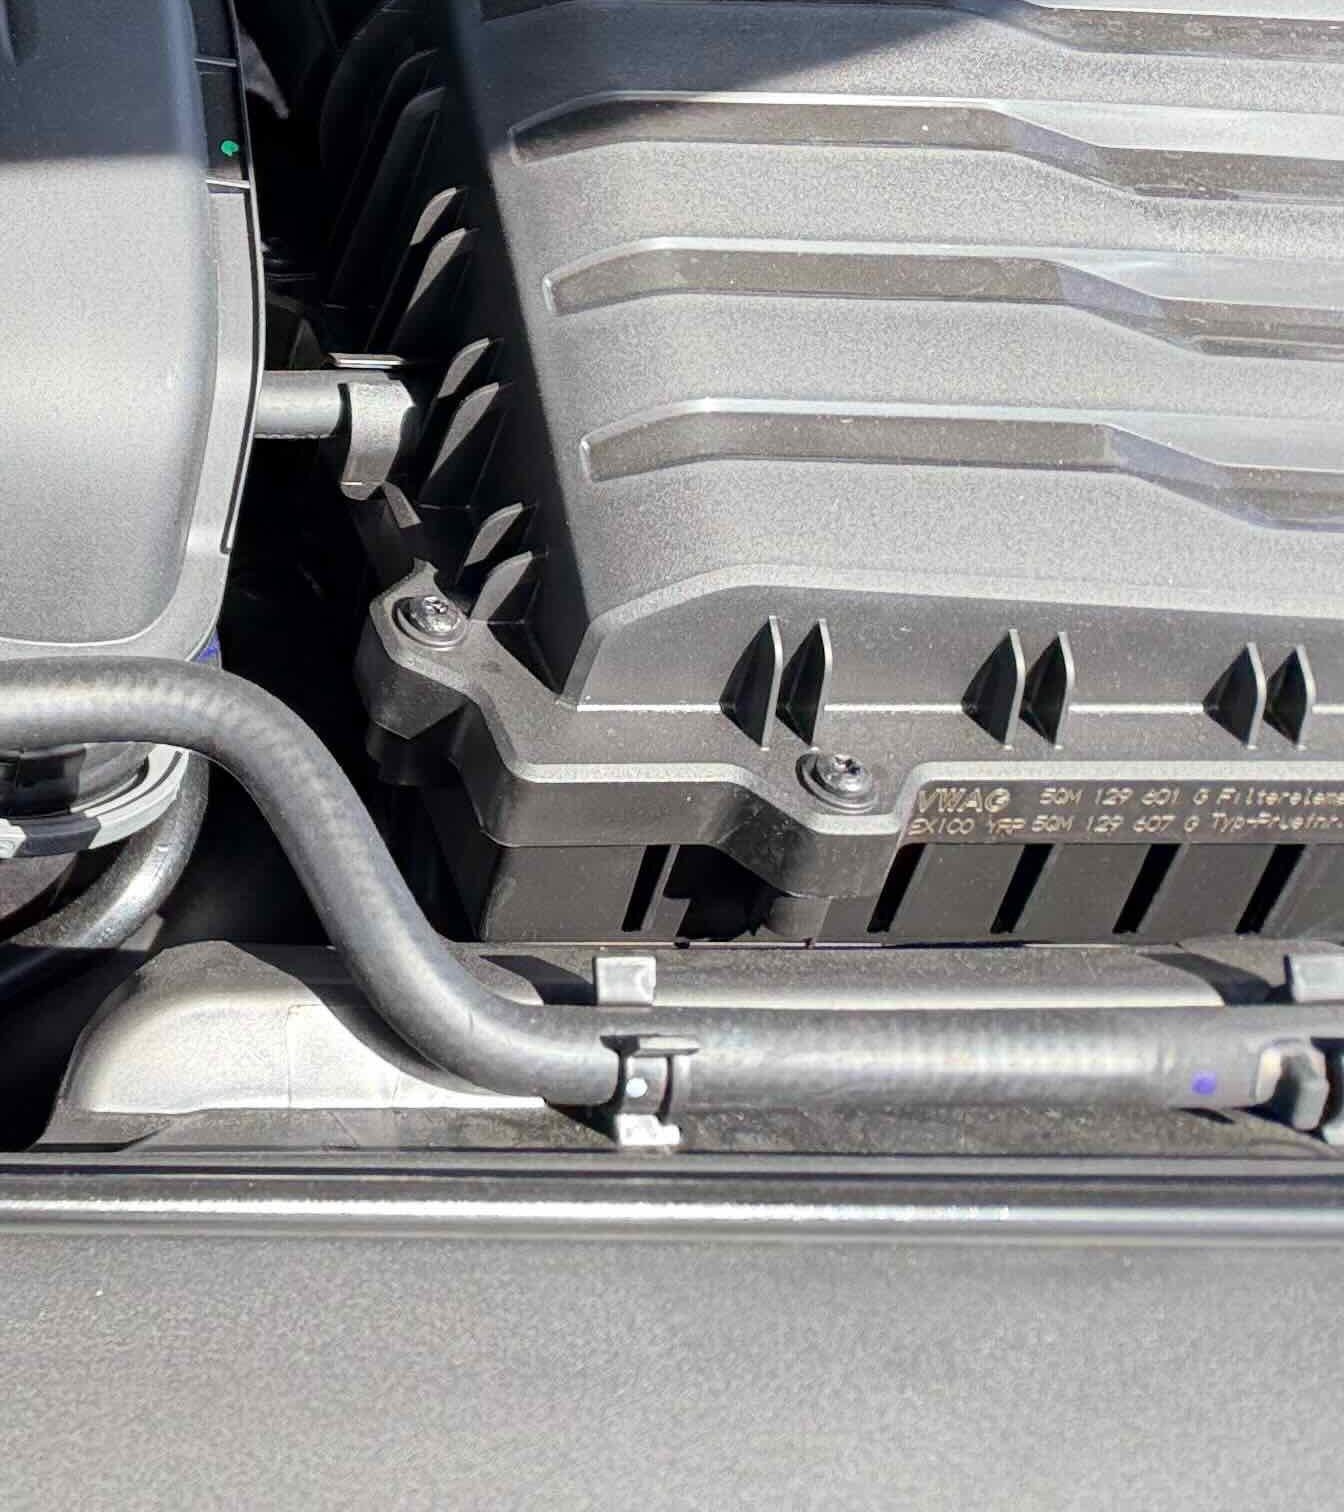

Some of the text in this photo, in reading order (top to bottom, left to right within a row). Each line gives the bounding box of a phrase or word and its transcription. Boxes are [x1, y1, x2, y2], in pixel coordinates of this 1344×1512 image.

[918, 787, 1010, 813] VWAG
[1095, 788, 1133, 806] 129
[1085, 815, 1124, 833] 129
